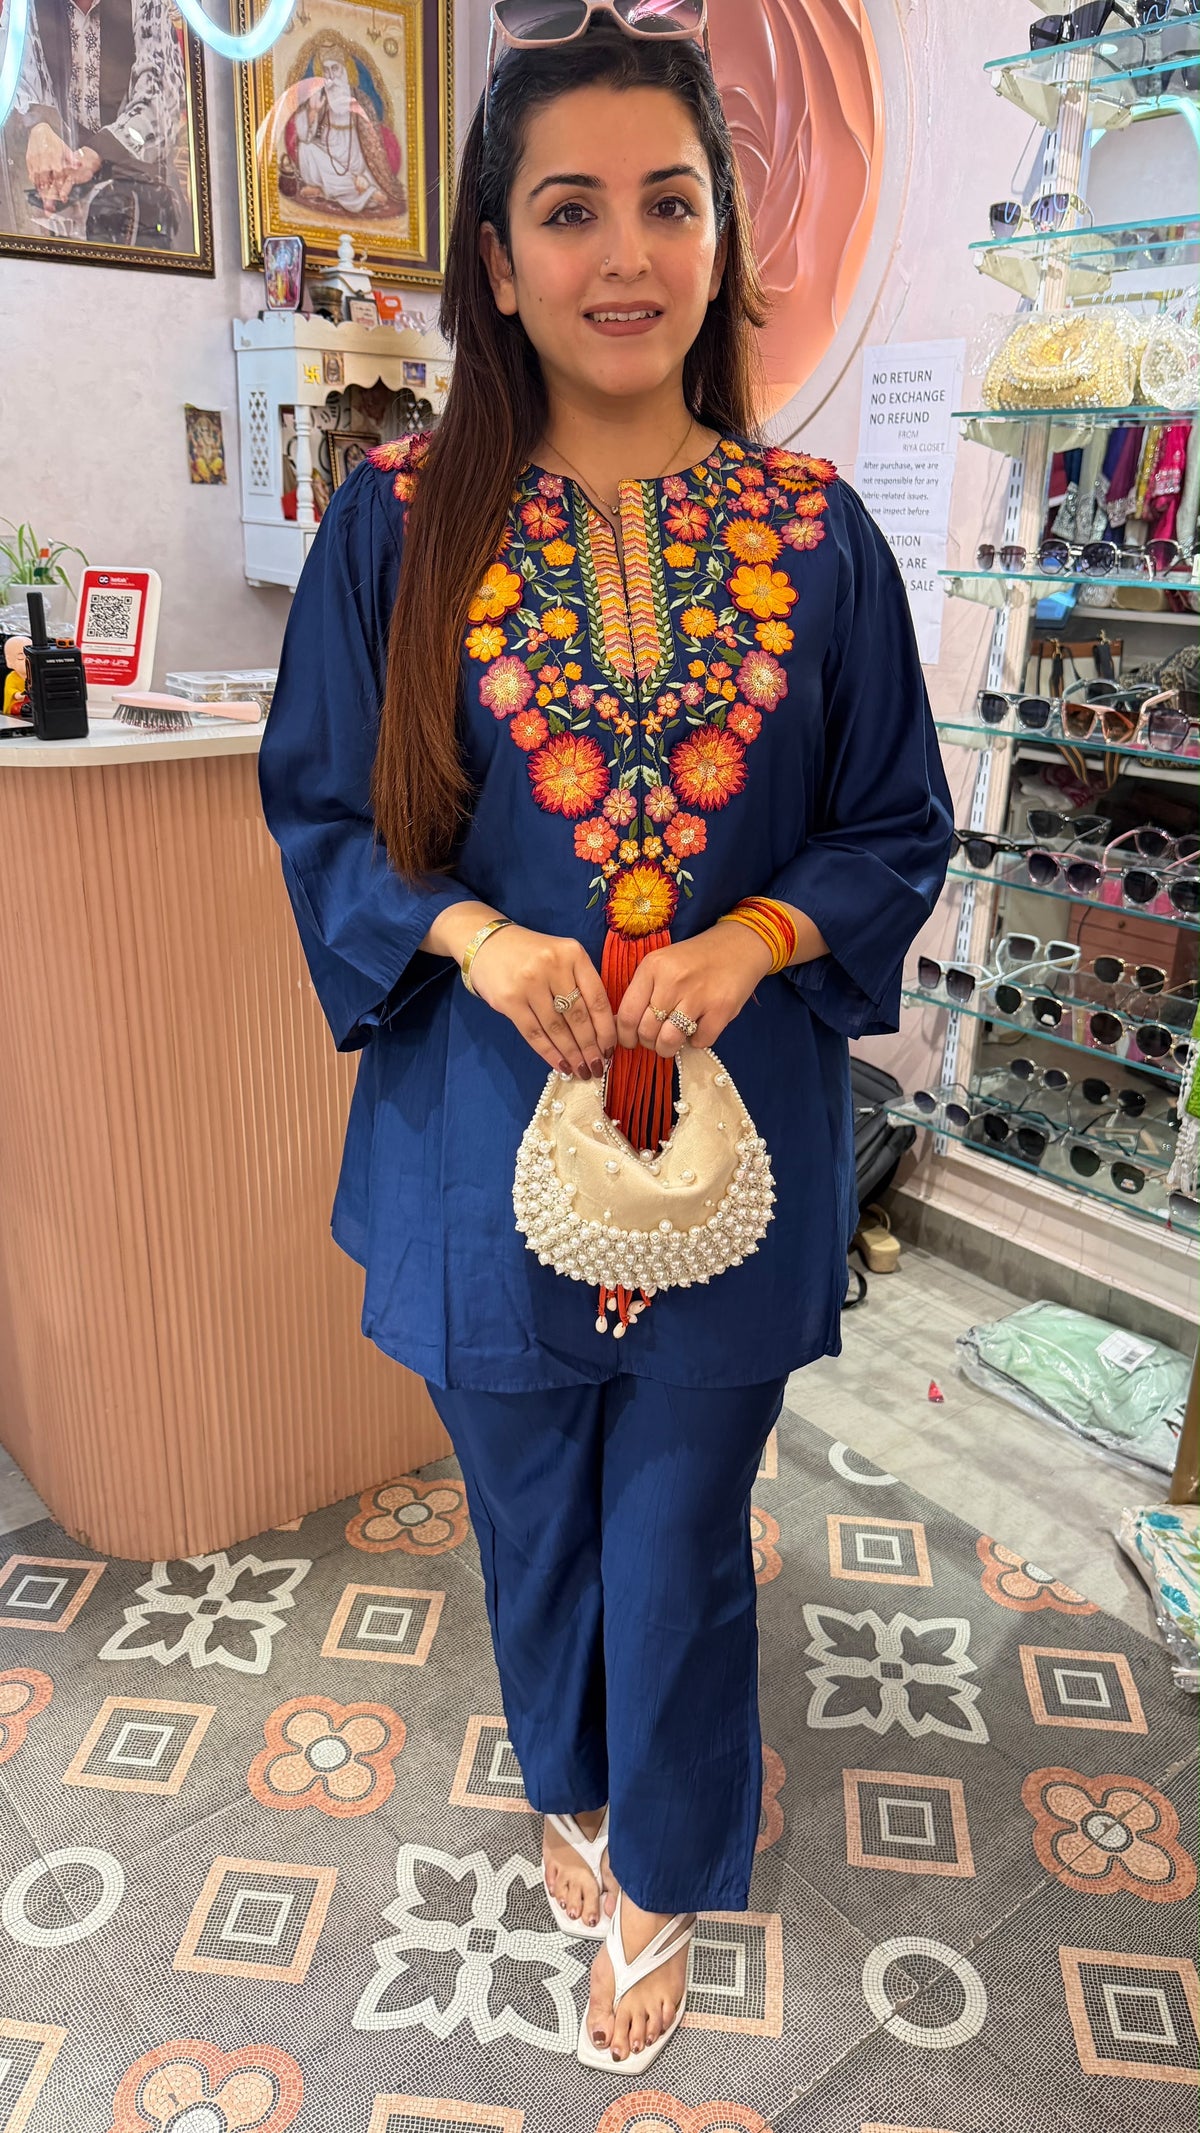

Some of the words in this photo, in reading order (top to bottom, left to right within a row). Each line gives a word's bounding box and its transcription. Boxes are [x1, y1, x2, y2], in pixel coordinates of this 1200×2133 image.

[872, 373, 887, 385] NO
[890, 370, 932, 384] RETURN
[871, 393, 886, 405] NO
[889, 390, 946, 405] EXCHANGE
[869, 413, 885, 425] NO
[887, 411, 930, 424] REFUND
[898, 430, 919, 439] FROM
[919, 442, 945, 452] CLOSET
[863, 462, 879, 470] After
[928, 462, 939, 470] are
[874, 476, 913, 486] responsible
[914, 476, 924, 485] for
[926, 477, 939, 486] any
[882, 507, 906, 517] inspect
[908, 507, 930, 516] before
[884, 535, 921, 547] ATION
[906, 558, 927, 569] ARE
[910, 580, 934, 592] SALE
